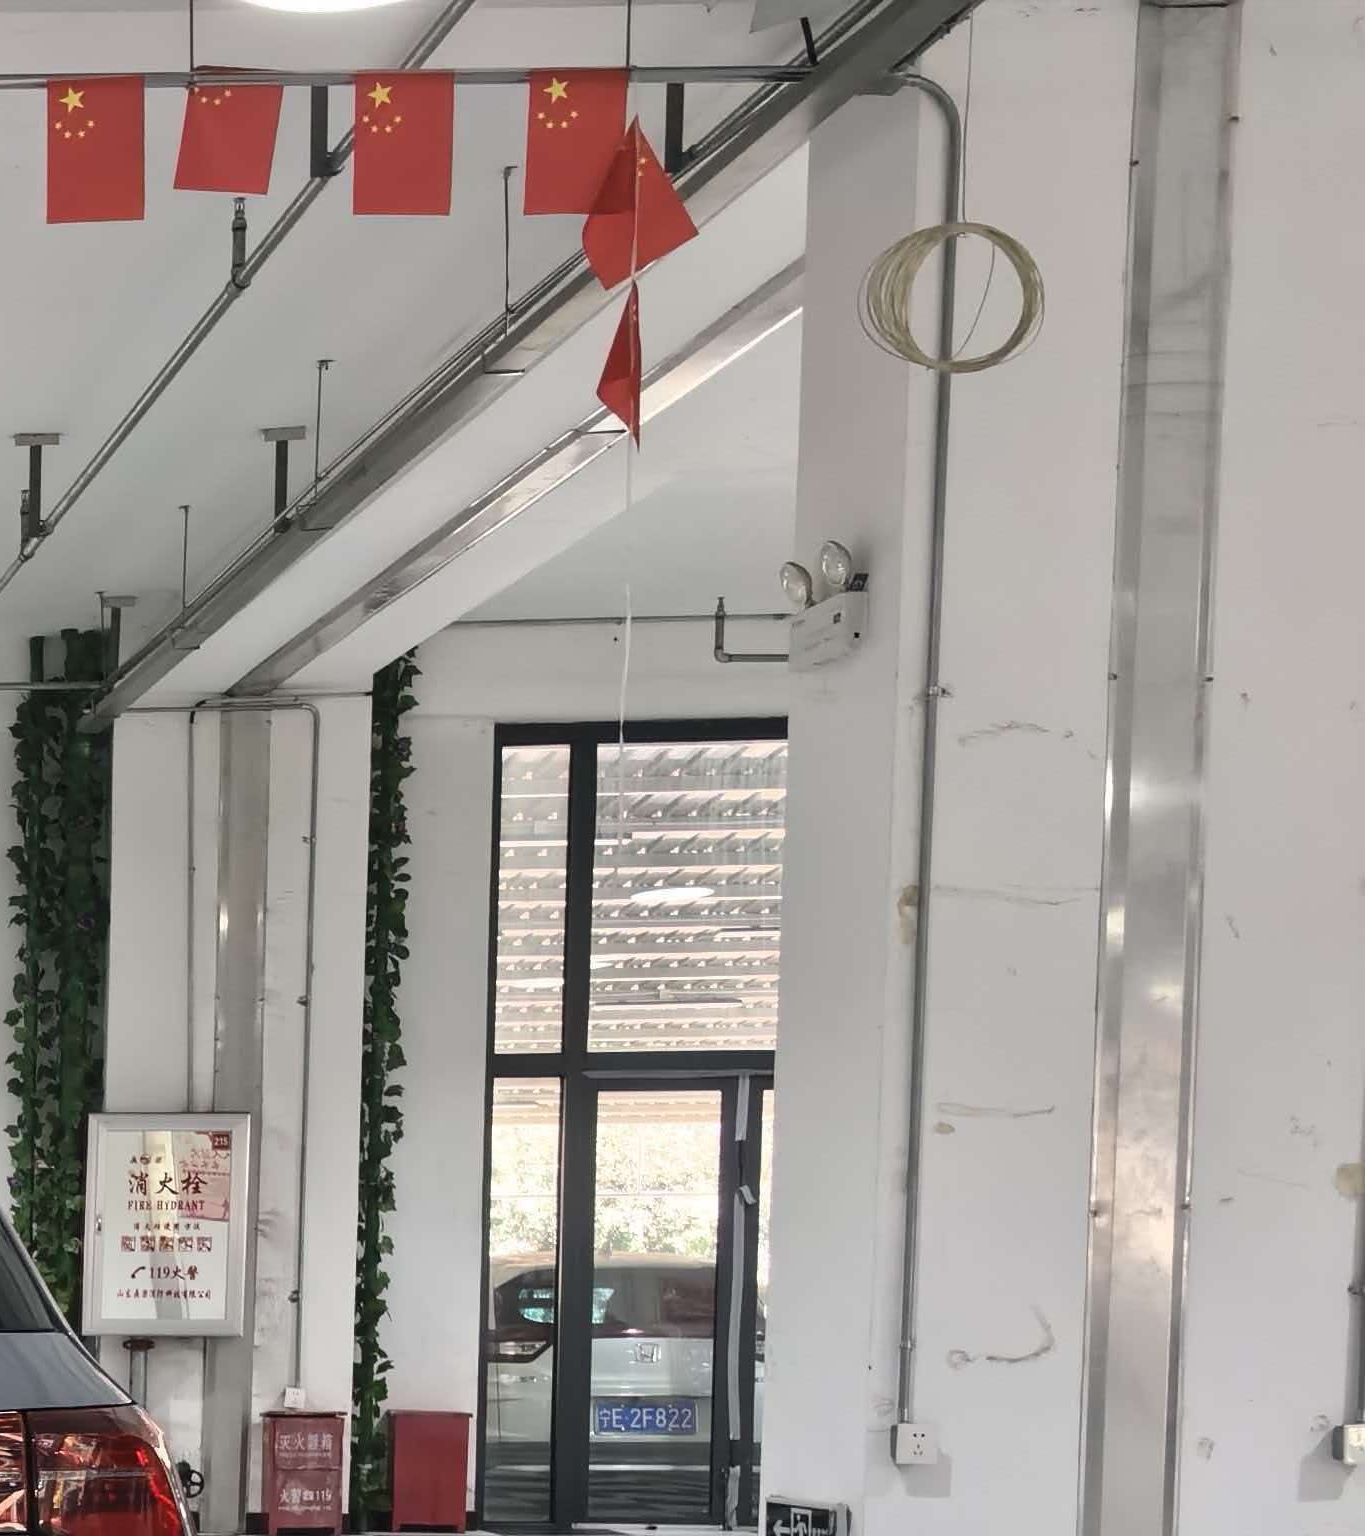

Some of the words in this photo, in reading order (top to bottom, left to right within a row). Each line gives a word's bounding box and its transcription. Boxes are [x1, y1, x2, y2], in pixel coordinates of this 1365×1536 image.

[128, 1172, 208, 1196] 消火栓
[128, 1200, 151, 1211] FIRE
[157, 1200, 205, 1211] HYDRANT
[150, 1264, 199, 1280] 119火警
